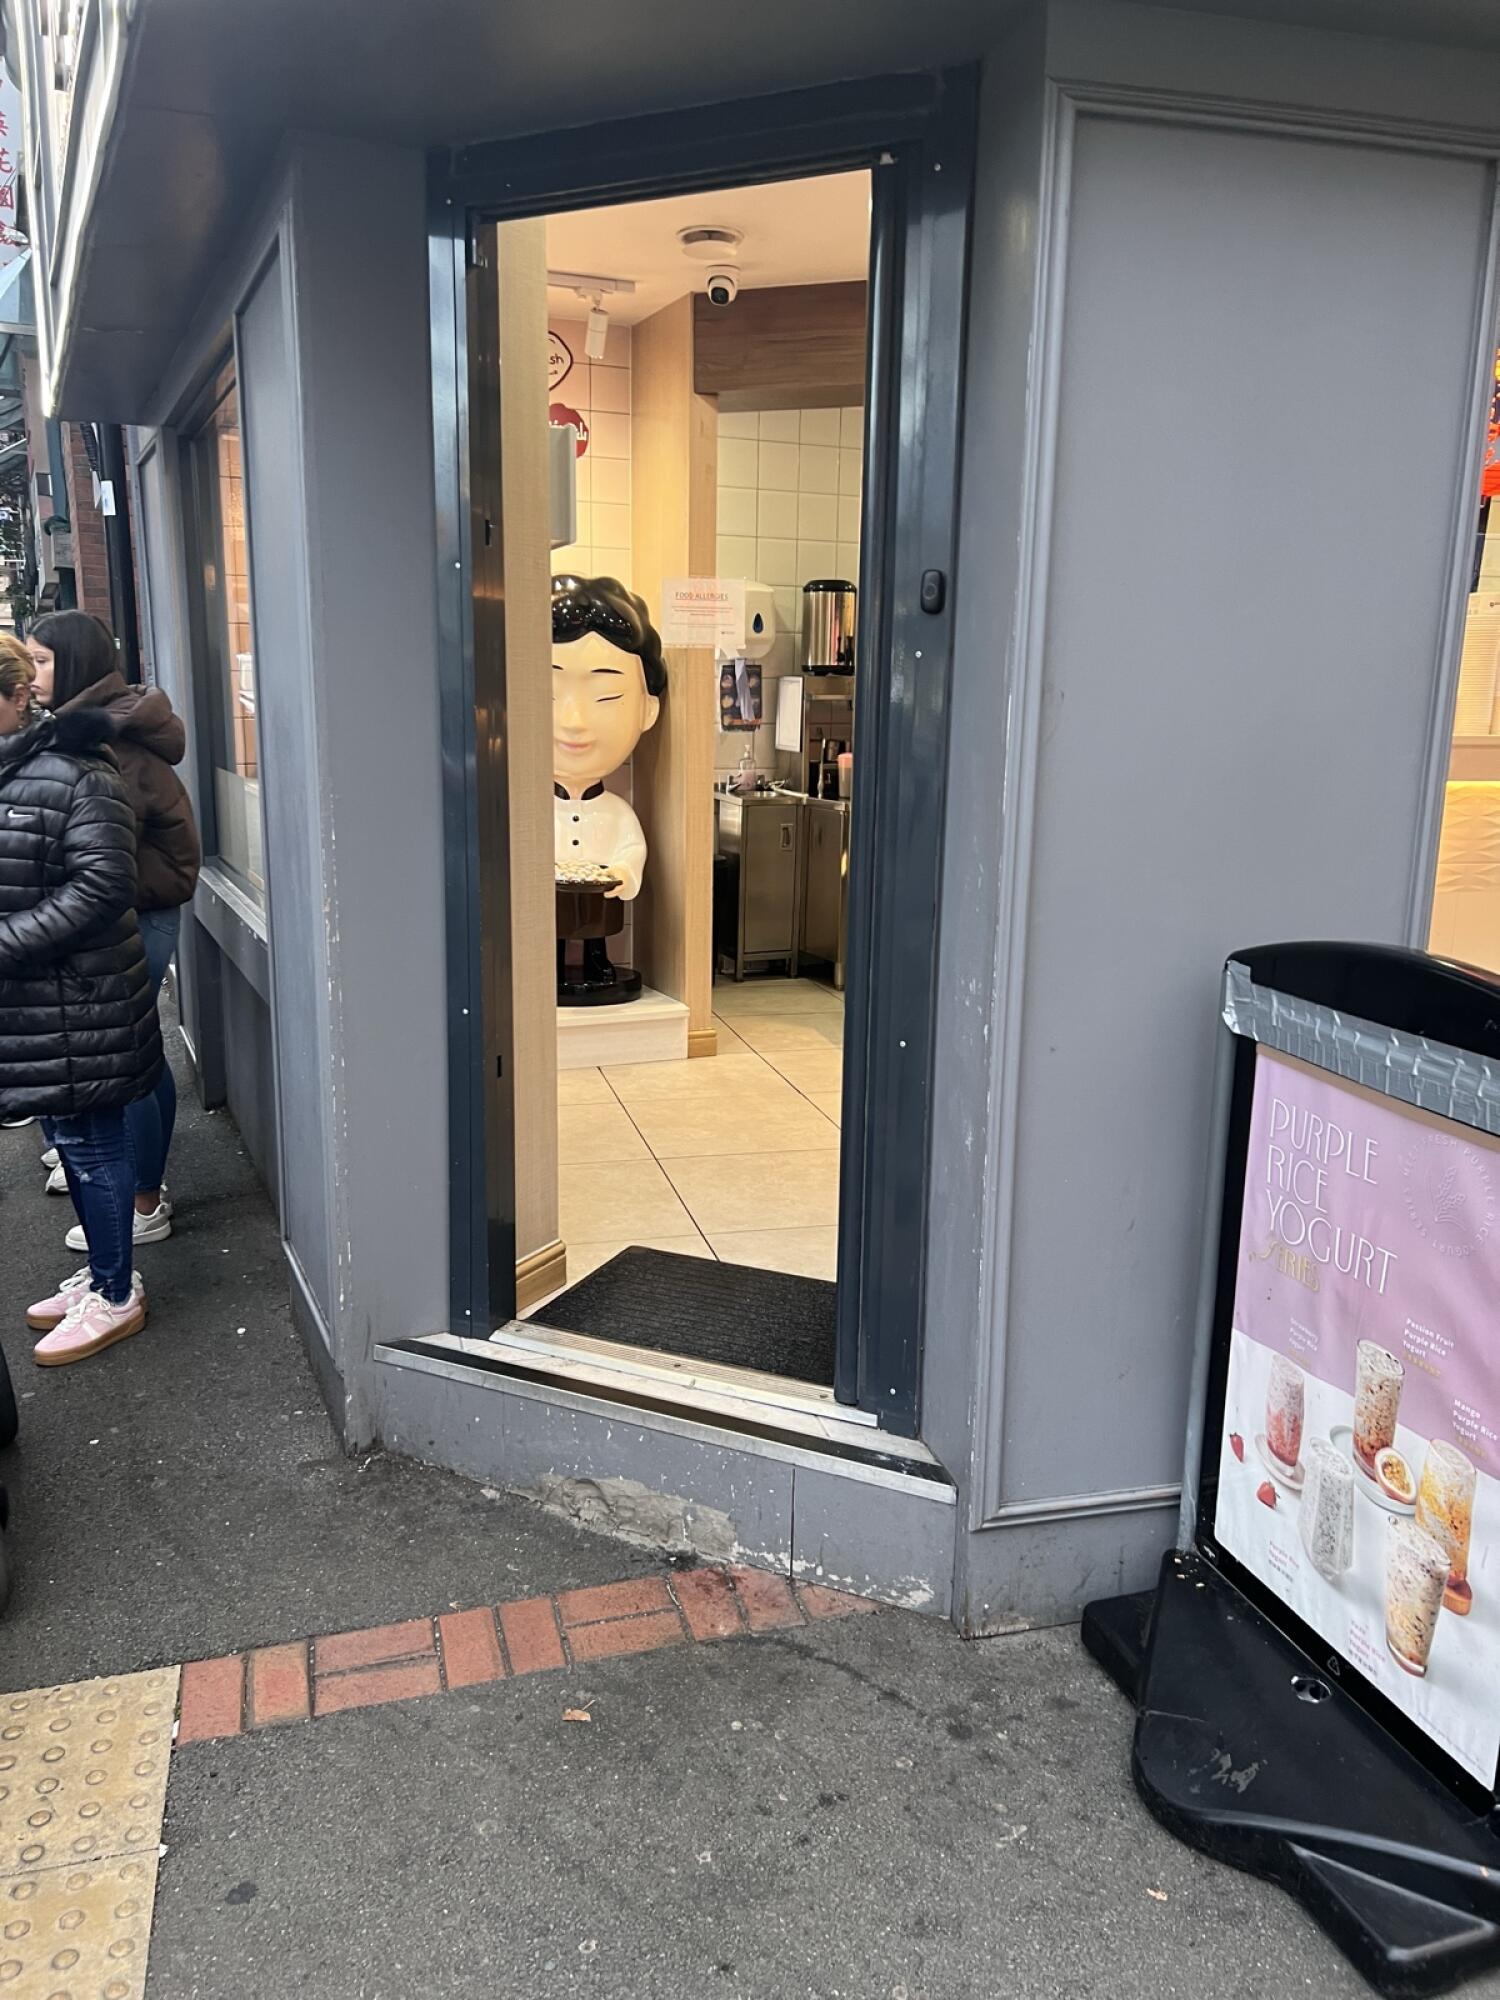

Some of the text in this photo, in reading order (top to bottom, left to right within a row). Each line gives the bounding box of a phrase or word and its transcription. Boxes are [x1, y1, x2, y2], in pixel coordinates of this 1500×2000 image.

[675, 592, 694, 601] FOOD
[1269, 1098, 1379, 1185] PURPLE
[1266, 1144, 1329, 1213] RICE
[1265, 1188, 1398, 1294] YOGURT
[1404, 1328, 1446, 1356] Purple Rice
[1405, 1317, 1455, 1348] Passion Fruit
[1402, 1340, 1427, 1358] Yogurt
[1454, 1399, 1481, 1419] Mango
[1452, 1410, 1498, 1441] Purple Rice
[1452, 1421, 1477, 1441] Yogurt
